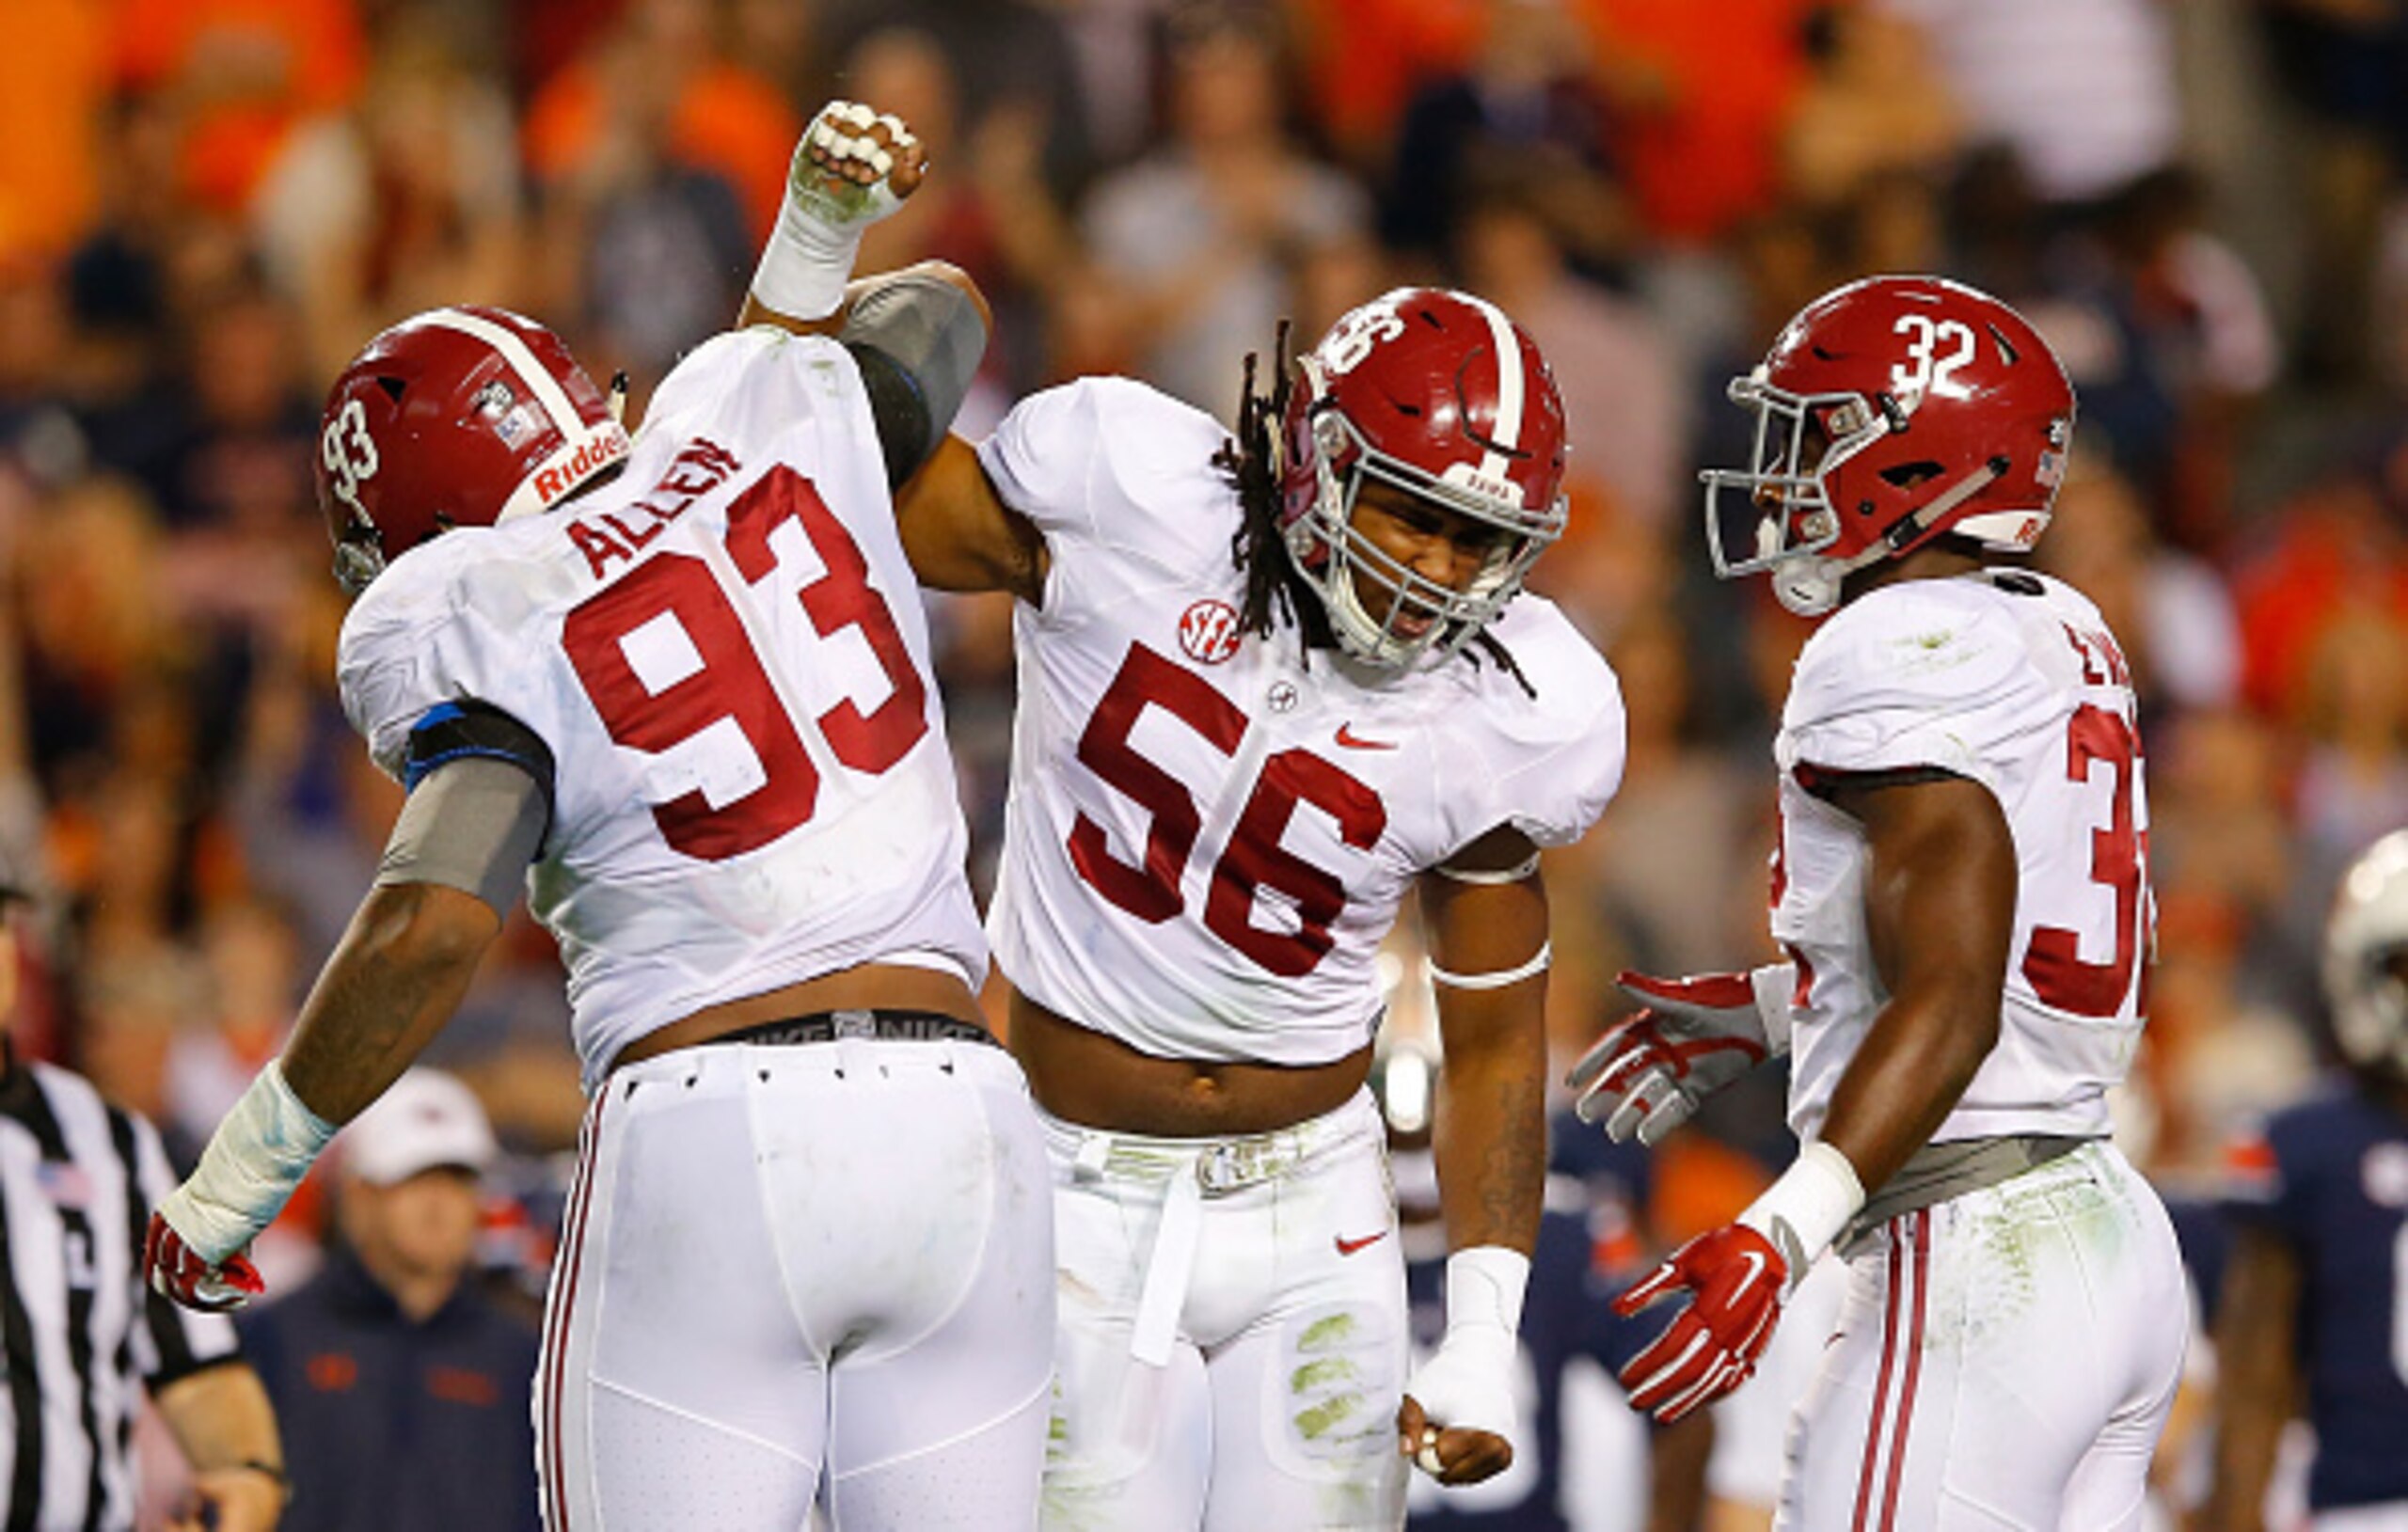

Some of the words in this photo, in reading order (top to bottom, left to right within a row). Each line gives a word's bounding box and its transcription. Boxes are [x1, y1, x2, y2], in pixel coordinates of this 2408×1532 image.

[323, 400, 378, 502] 93
[1892, 315, 1975, 402] 32
[565, 436, 741, 581] ALLEN
[562, 462, 929, 862] 93
[1067, 640, 1387, 978] 56
[2021, 702, 2151, 1018] 3
